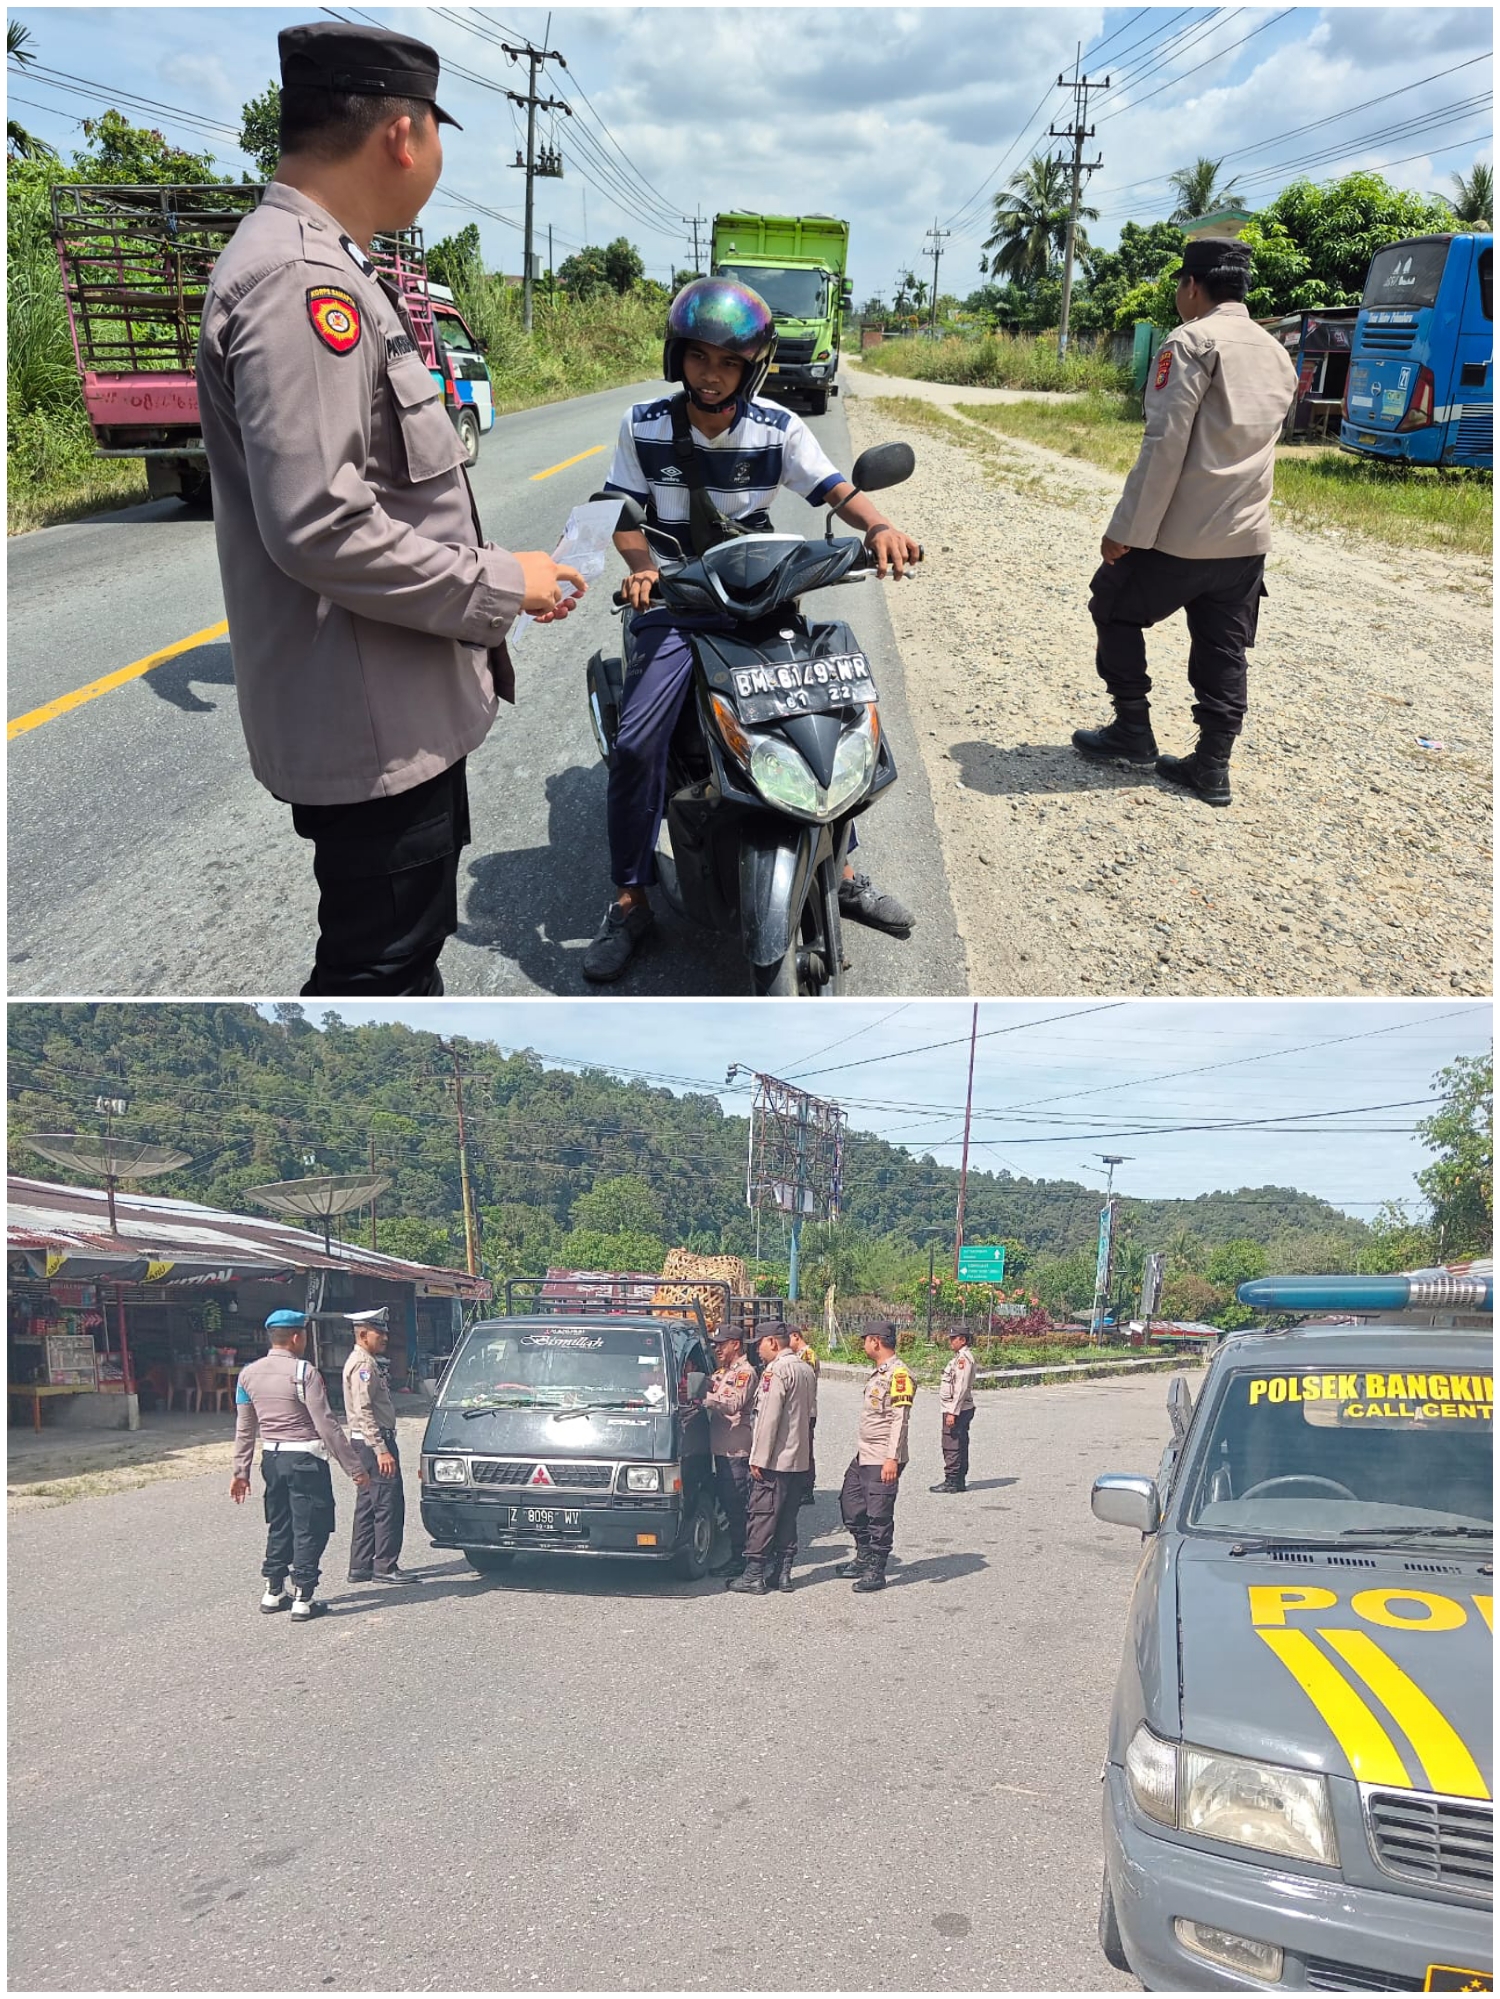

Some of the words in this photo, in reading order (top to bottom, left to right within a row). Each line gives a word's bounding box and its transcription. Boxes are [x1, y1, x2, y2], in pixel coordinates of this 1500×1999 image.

[736, 671, 769, 697] BM
[828, 686, 851, 700] 22
[520, 1335, 605, 1348] Bismillah
[1249, 1374, 1360, 1405] POLSEK
[1347, 1403, 1415, 1418] CALL
[510, 1508, 518, 1522] Z
[527, 1509, 554, 1524] 8096
[564, 1512, 579, 1525] WV
[1248, 1585, 1494, 1635] PO
